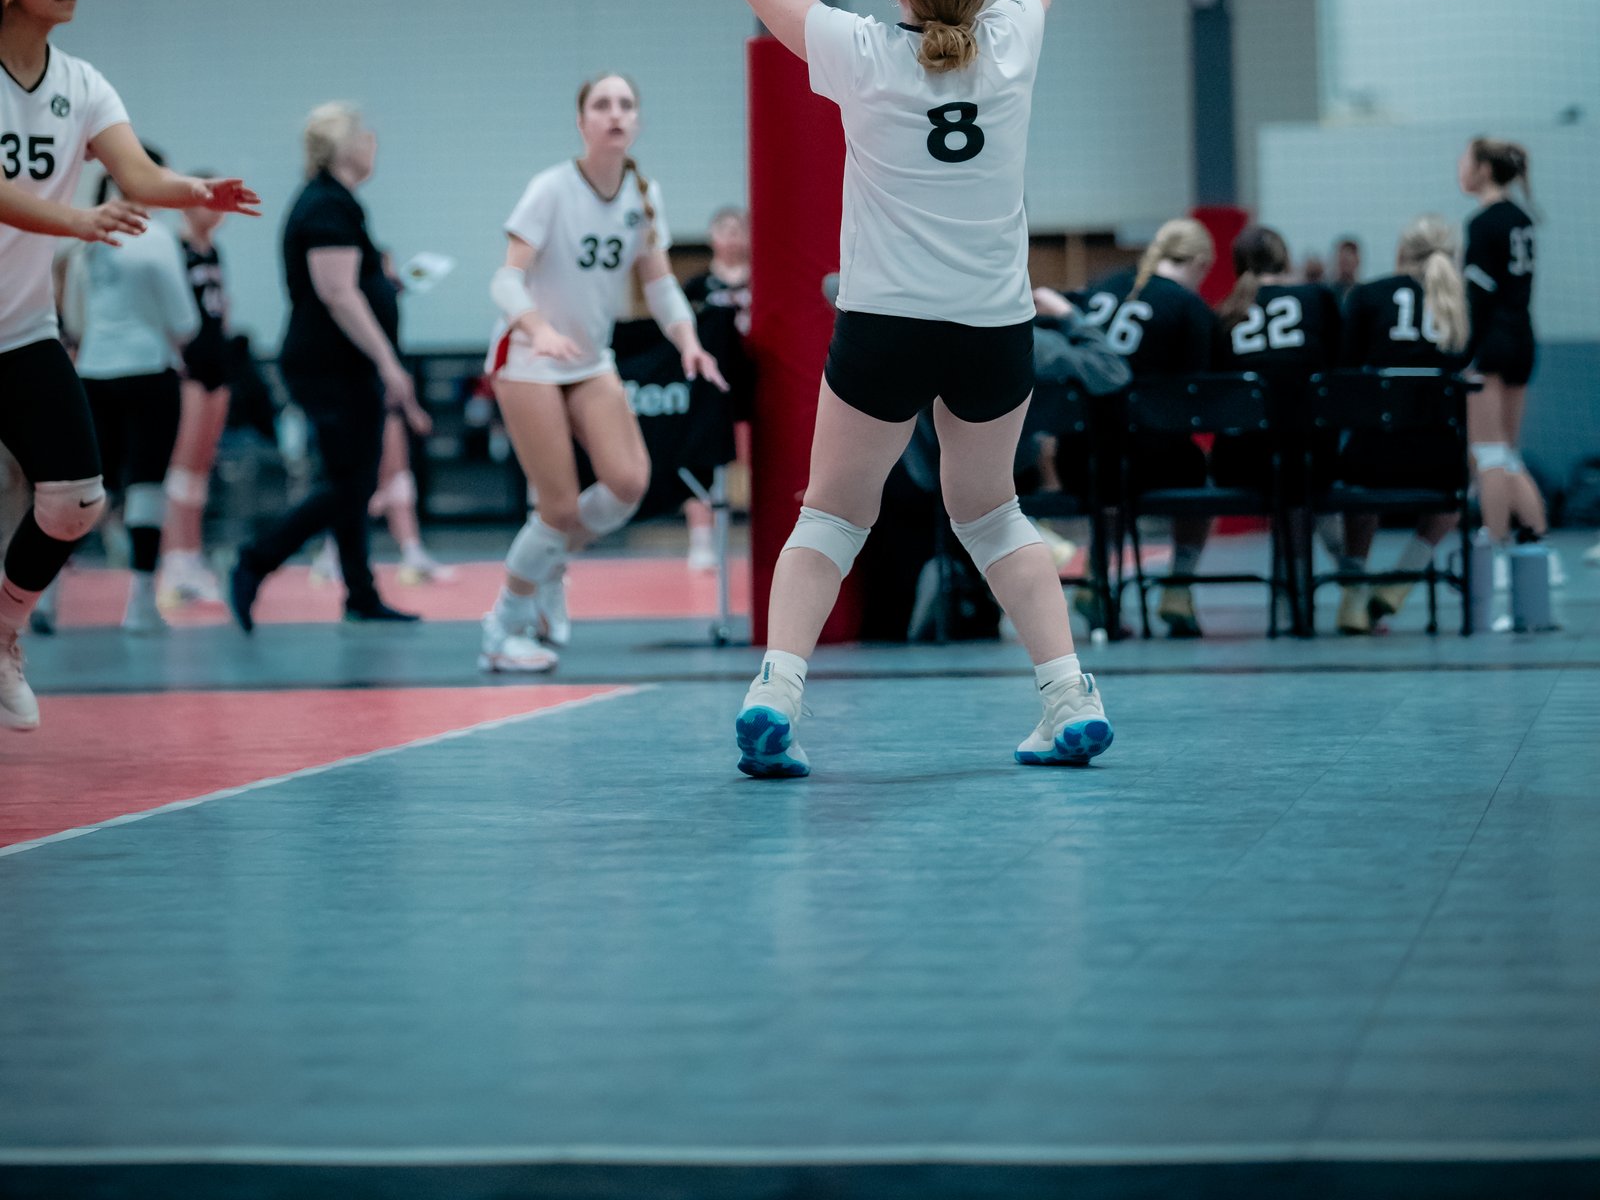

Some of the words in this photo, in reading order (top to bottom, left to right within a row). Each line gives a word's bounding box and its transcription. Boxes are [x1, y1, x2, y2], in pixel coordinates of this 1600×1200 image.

[0, 133, 55, 180] 35
[927, 102, 984, 163] 8
[579, 236, 622, 269] 33
[1087, 292, 1153, 355] 26
[1231, 295, 1305, 355] 22
